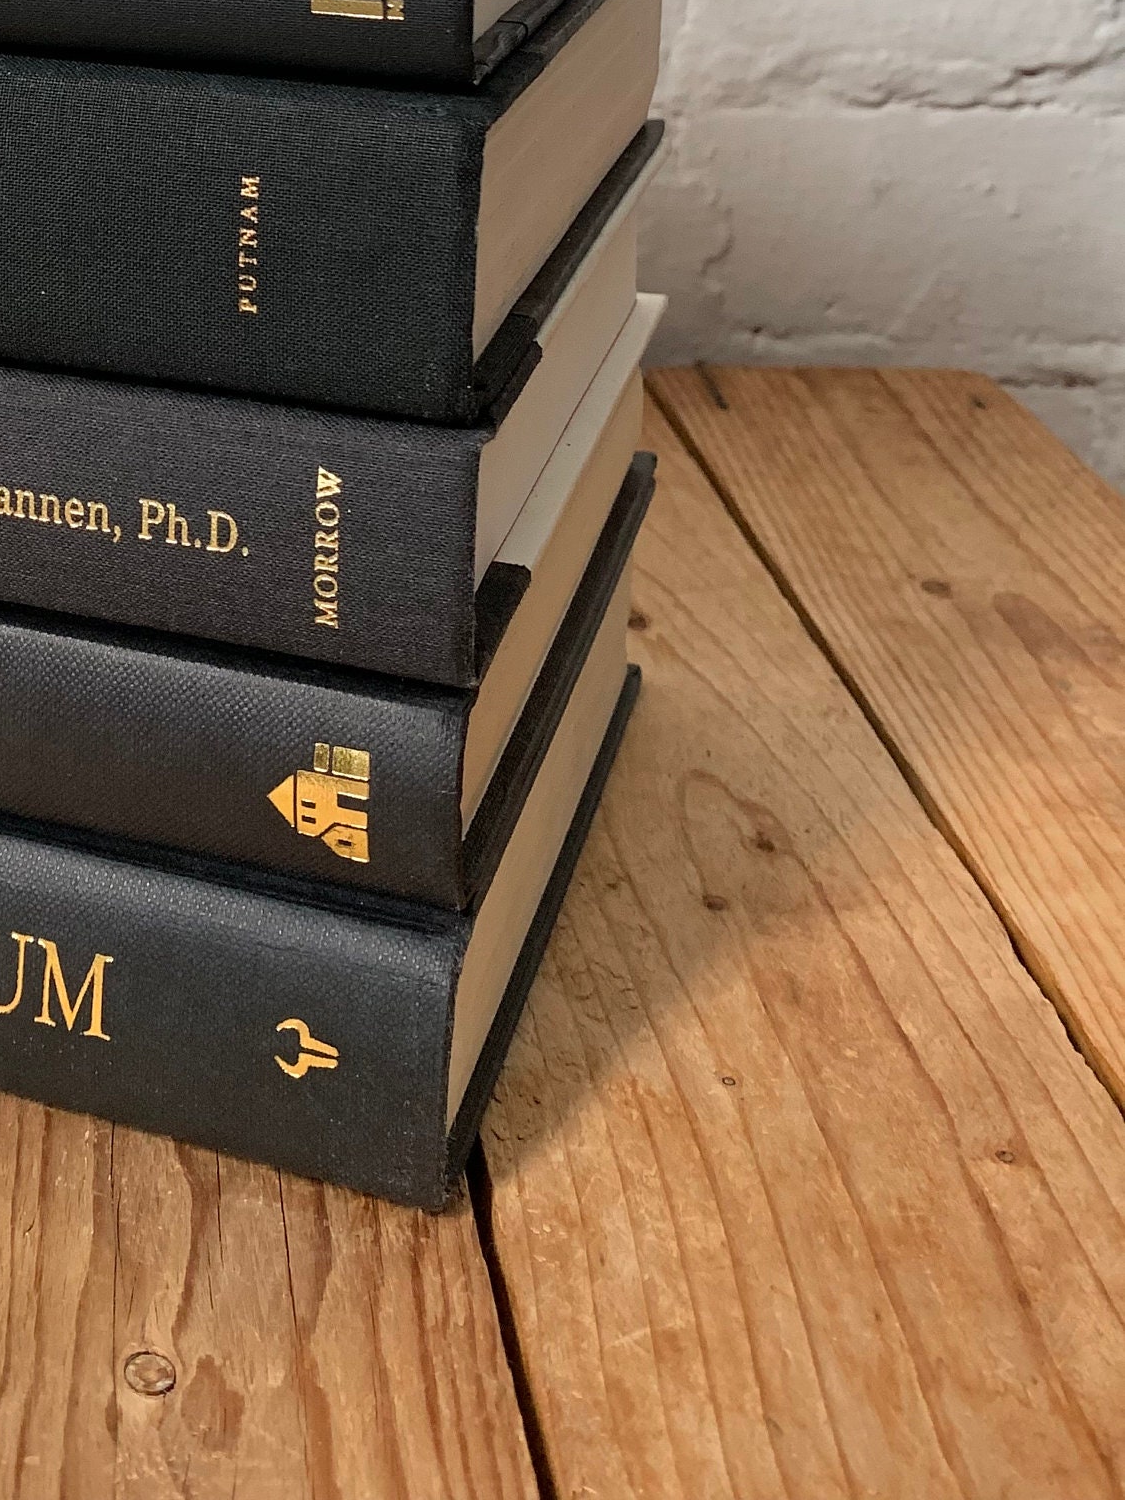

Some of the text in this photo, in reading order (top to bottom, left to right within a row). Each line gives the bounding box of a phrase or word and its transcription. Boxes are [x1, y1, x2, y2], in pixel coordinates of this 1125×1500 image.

[238, 176, 260, 314] PUTNAM
[137, 497, 249, 556] Ph.D.
[313, 466, 343, 629] MORROW
